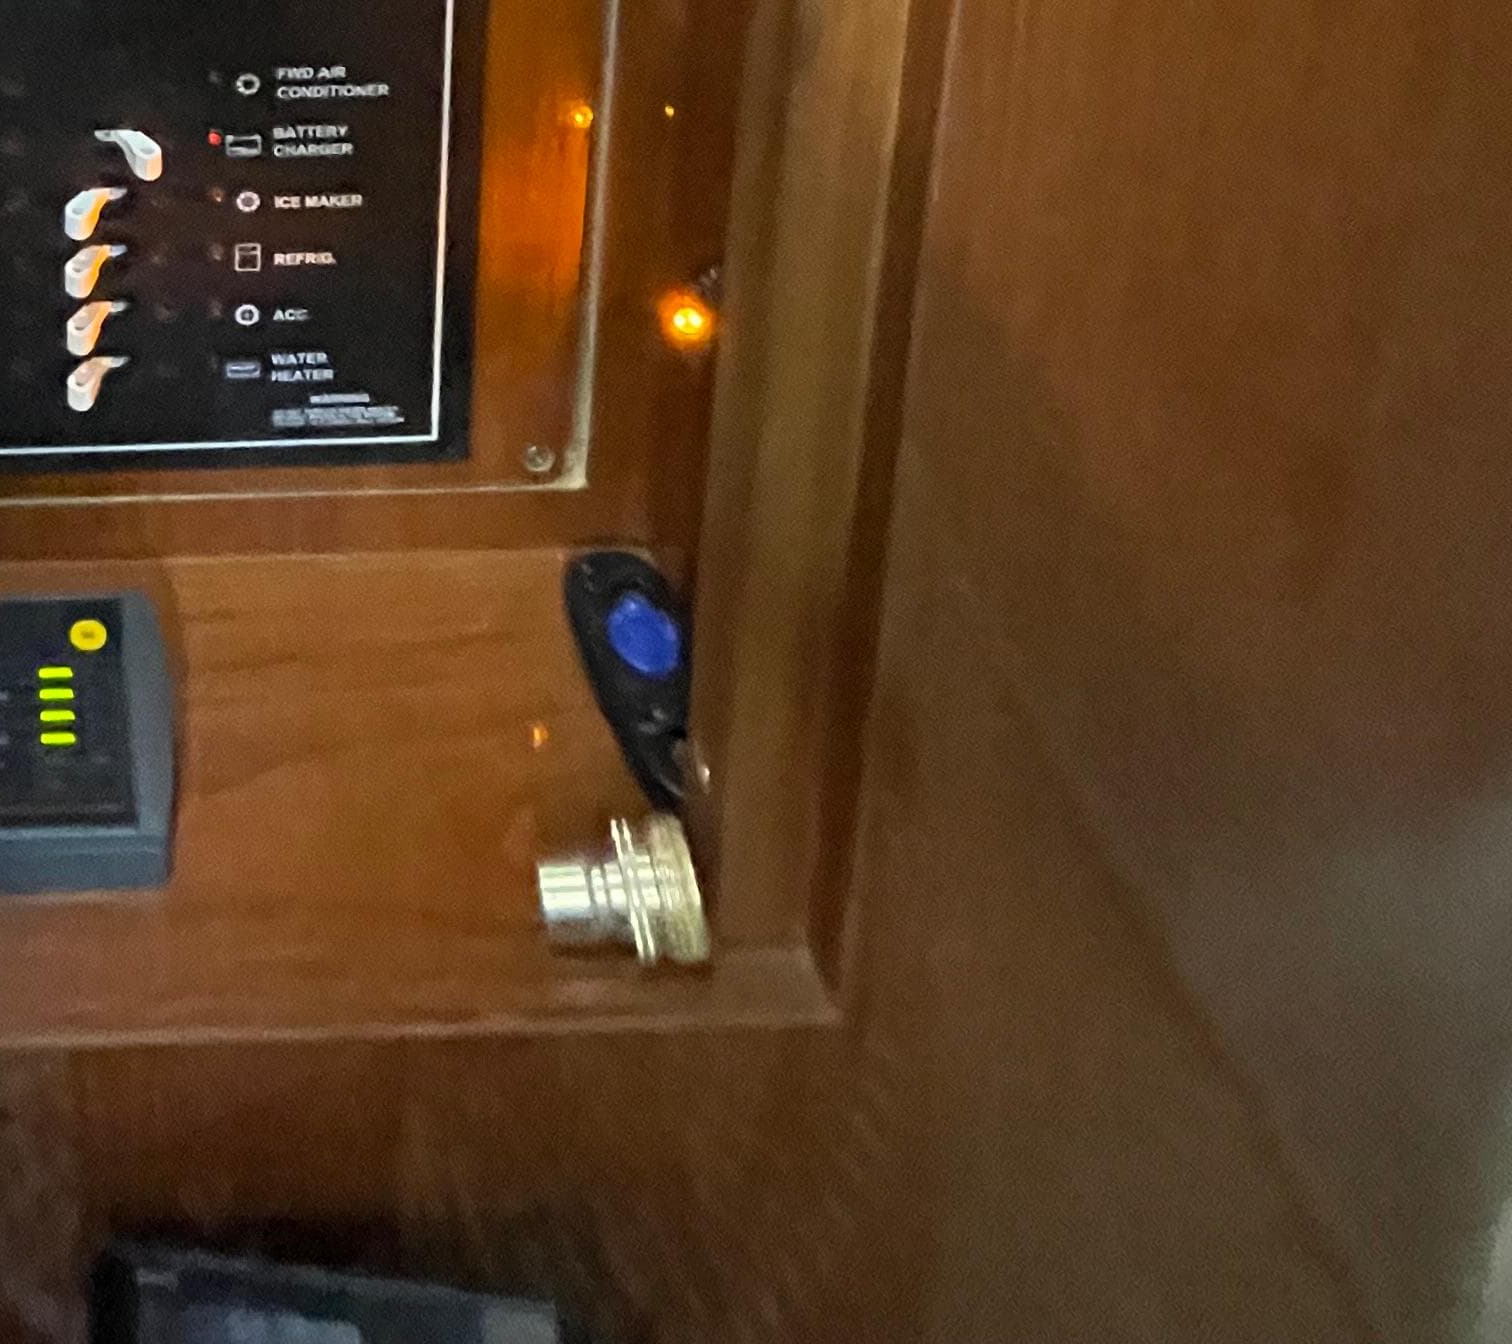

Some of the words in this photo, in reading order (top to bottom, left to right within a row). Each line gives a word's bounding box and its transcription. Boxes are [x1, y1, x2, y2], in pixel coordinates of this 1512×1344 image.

[316, 66, 346, 79] AIR
[277, 84, 389, 99] CONDITIONER
[272, 125, 348, 140] BATTERY
[273, 143, 353, 157] CHARGER
[274, 196, 300, 209] ICE
[305, 194, 363, 208] MAKER
[271, 352, 328, 365] WATER
[271, 368, 334, 381] HEATER
